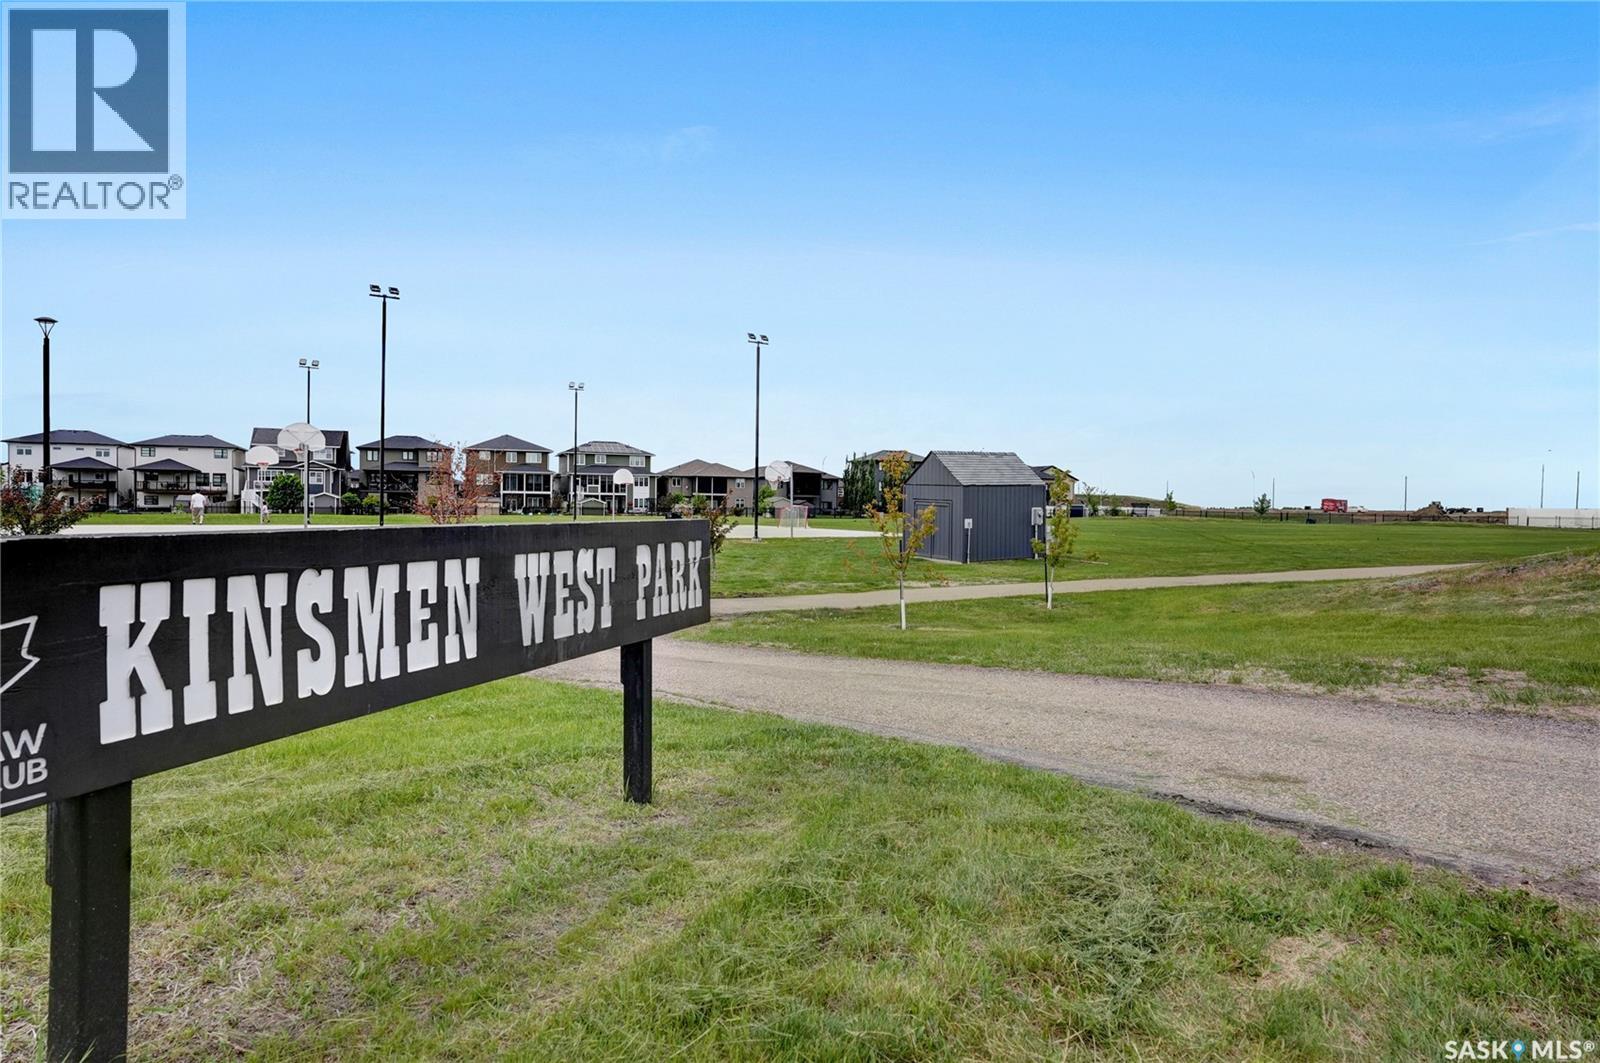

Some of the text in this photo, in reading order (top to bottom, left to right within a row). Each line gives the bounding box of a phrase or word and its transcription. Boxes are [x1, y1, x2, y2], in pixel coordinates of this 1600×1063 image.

[99, 540, 703, 745] KINSMEN WEST PARK
[0, 757, 48, 792] UB
